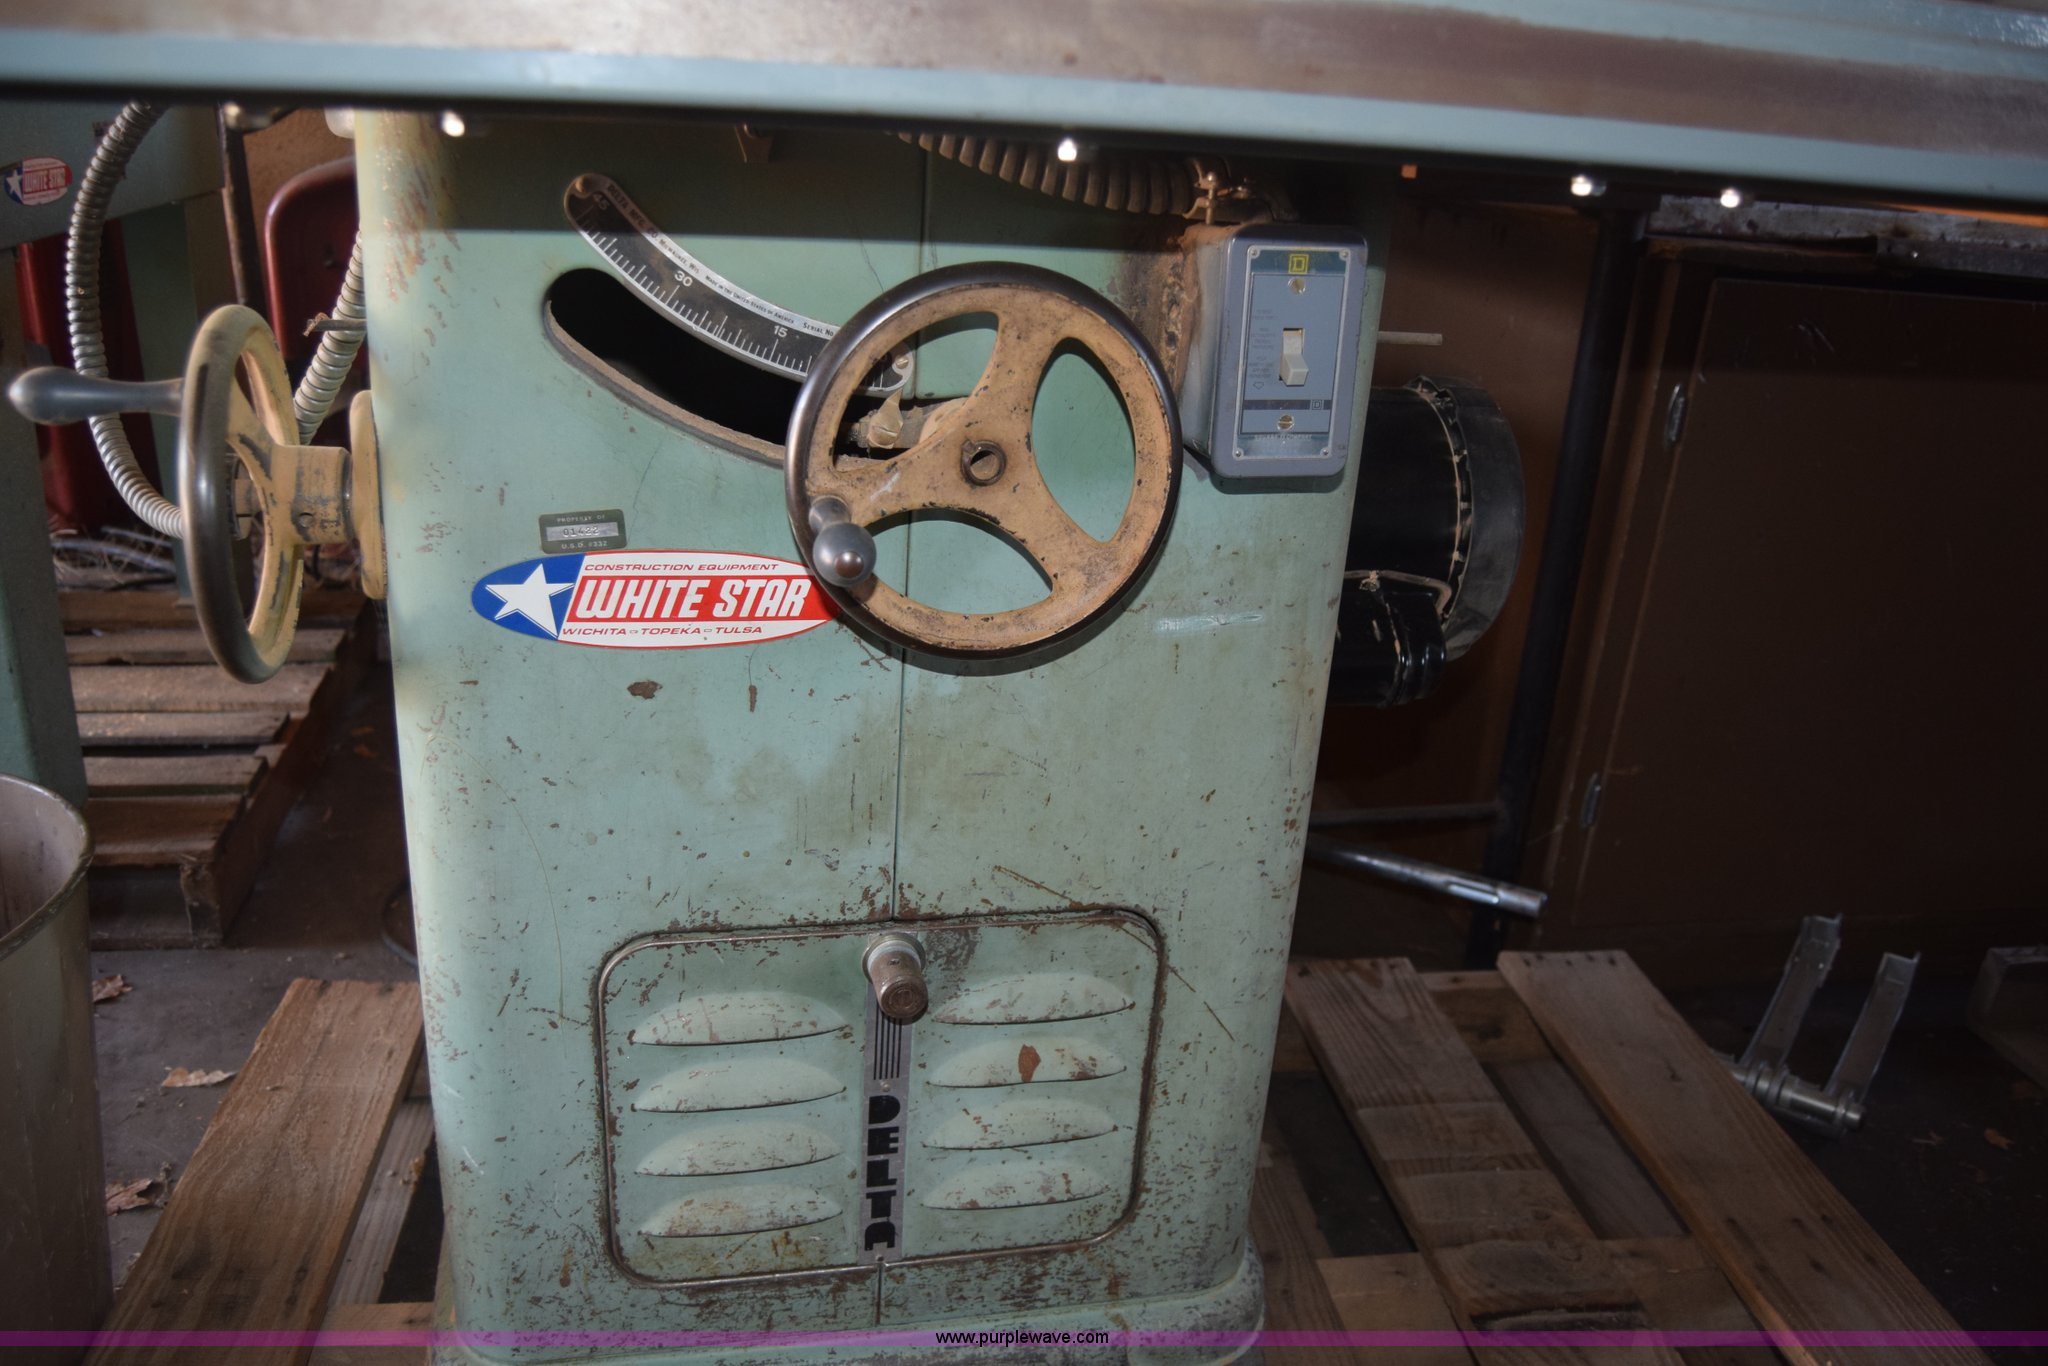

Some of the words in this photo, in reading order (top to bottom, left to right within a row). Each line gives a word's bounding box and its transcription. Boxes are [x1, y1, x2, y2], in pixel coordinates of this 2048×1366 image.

[674, 270, 693, 287] 30
[773, 325, 788, 338] 15
[563, 526, 600, 538] 01422
[575, 579, 711, 619] WHITE
[712, 579, 812, 618] STAR
[641, 627, 701, 635] TOPEKA
[715, 626, 762, 634] TULSA
[864, 1095, 901, 1251] DELTA
